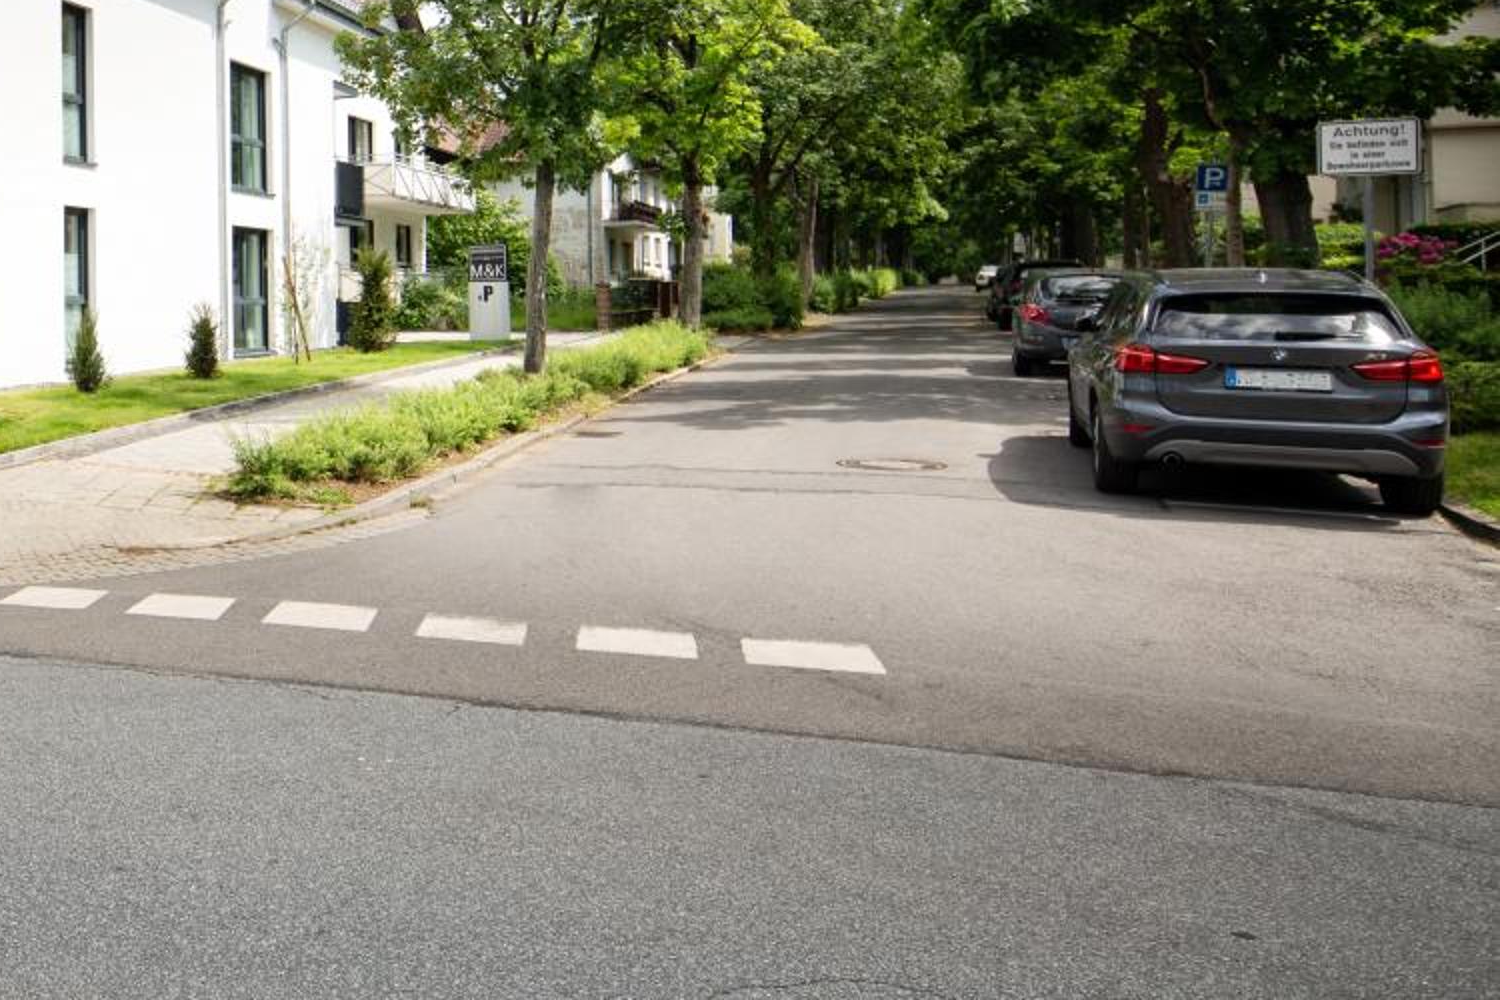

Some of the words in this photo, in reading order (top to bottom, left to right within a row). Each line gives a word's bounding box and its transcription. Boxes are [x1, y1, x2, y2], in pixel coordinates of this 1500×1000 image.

[1333, 123, 1406, 137] Achtung!
[470, 263, 504, 279] M&K
[483, 286, 493, 302] P
